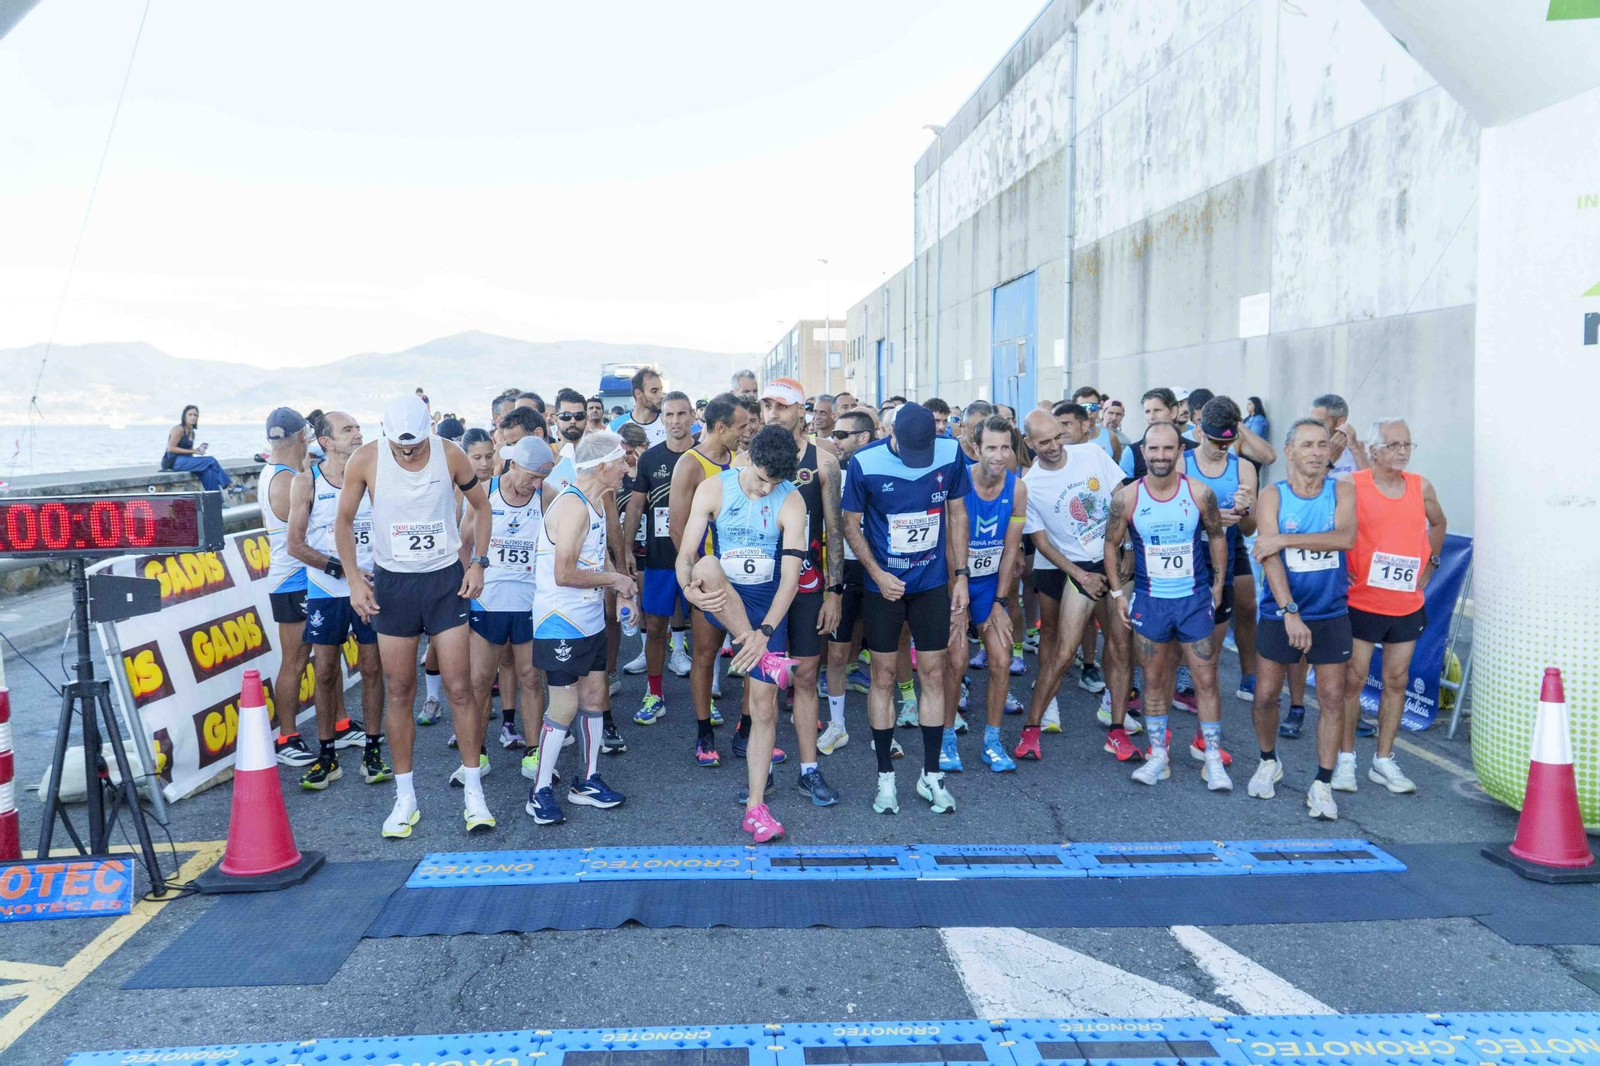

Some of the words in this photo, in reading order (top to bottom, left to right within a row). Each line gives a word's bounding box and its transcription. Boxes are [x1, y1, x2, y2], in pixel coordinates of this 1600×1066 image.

[1067, 480, 1086, 491] Mauri
[907, 527, 930, 543] 27
[409, 535, 435, 551] 23
[498, 549, 530, 564] 153
[974, 556, 992, 570] 66
[1161, 556, 1183, 569] 70
[743, 559, 756, 574] 6
[1381, 565, 1414, 582] 156
[144, 550, 225, 599] GADIS
[191, 611, 263, 670] GADIS
[589, 858, 741, 870] CRONOTEC
[833, 1025, 941, 1037] CRONOTEC
[1059, 1022, 1164, 1033] CRONOTEC
[601, 1031, 712, 1043] CRONOTEC
[1250, 1039, 1456, 1058] CRONOTEC
[121, 1049, 239, 1064] CRONOTEC
